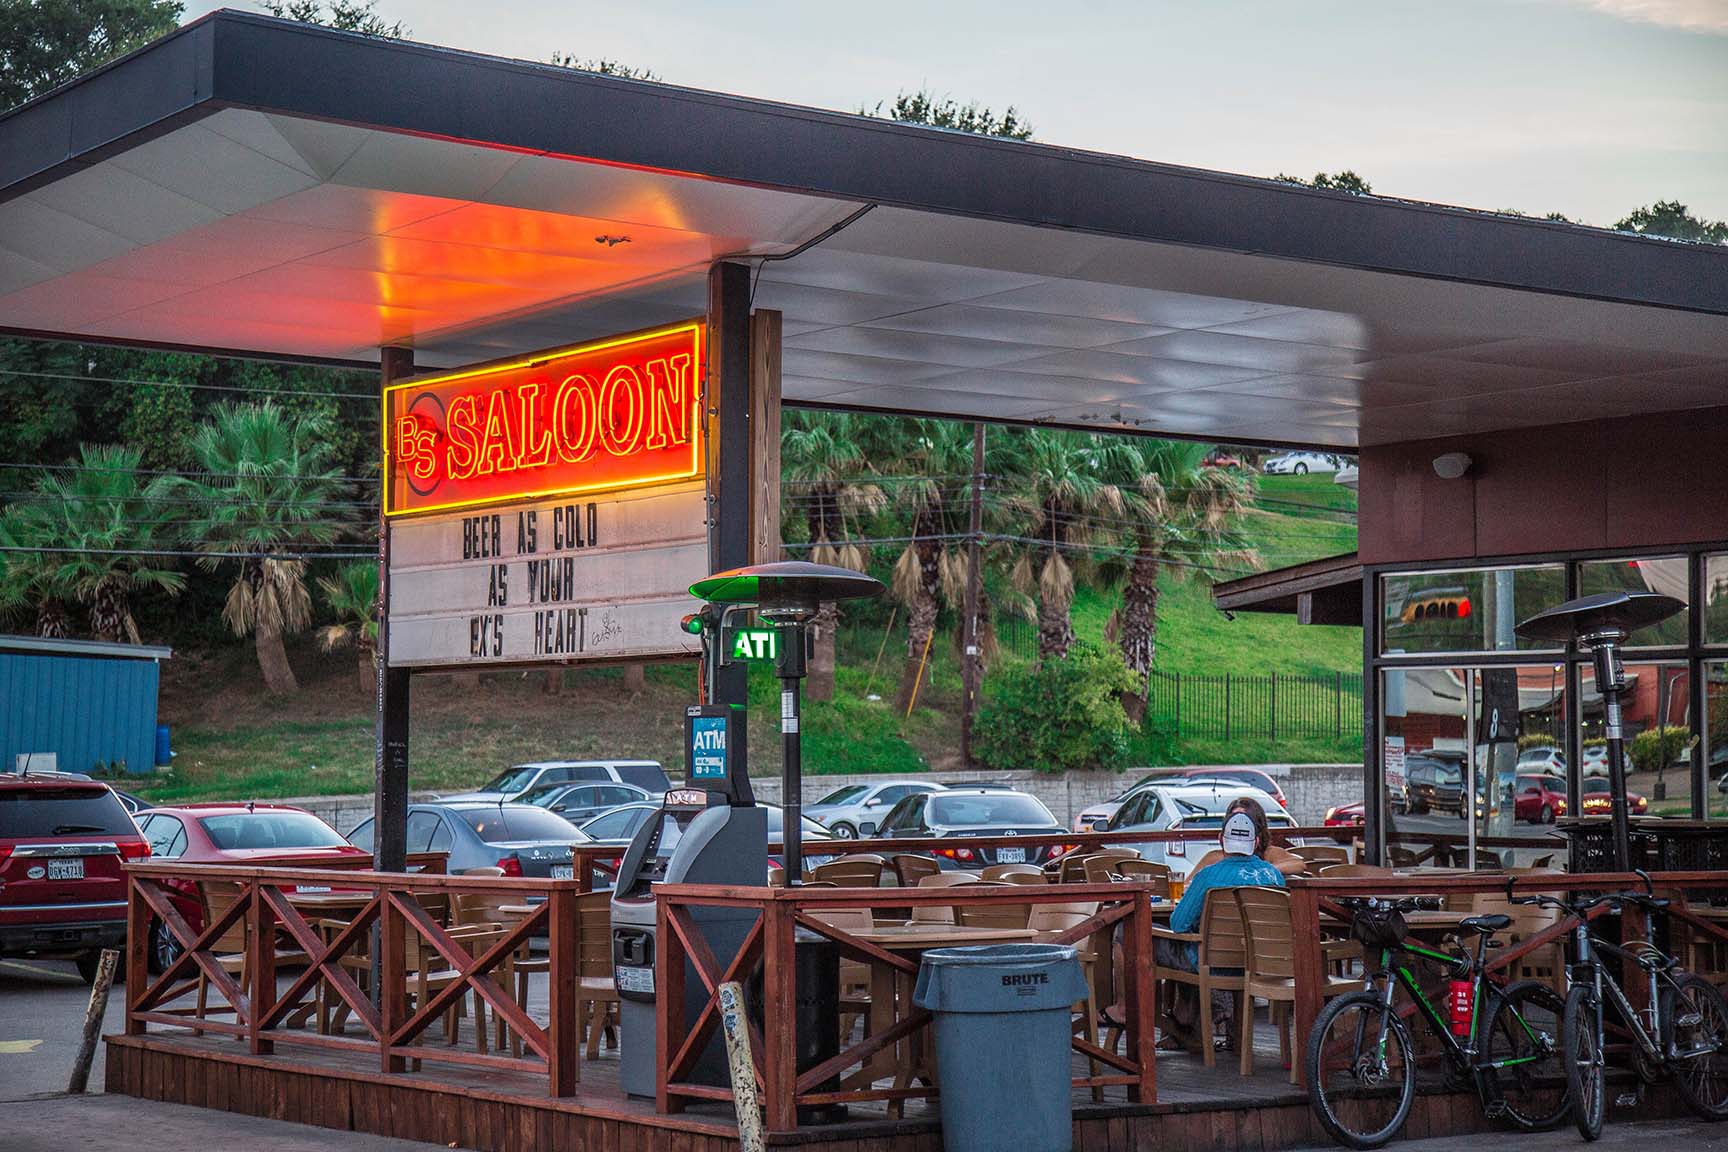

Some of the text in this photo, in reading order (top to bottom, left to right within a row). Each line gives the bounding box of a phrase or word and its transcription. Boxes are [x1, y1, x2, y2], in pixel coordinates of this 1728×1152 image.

[447, 354, 690, 479] SALOON
[462, 514, 501, 560] BEER
[518, 510, 537, 555] AS
[488, 557, 574, 607] AS YOUR
[470, 614, 504, 657] EX'S
[534, 607, 588, 655] HEART
[693, 730, 726, 751] ATM
[676, 793, 697, 802] ATM
[1001, 973, 1049, 986] BRUTE
